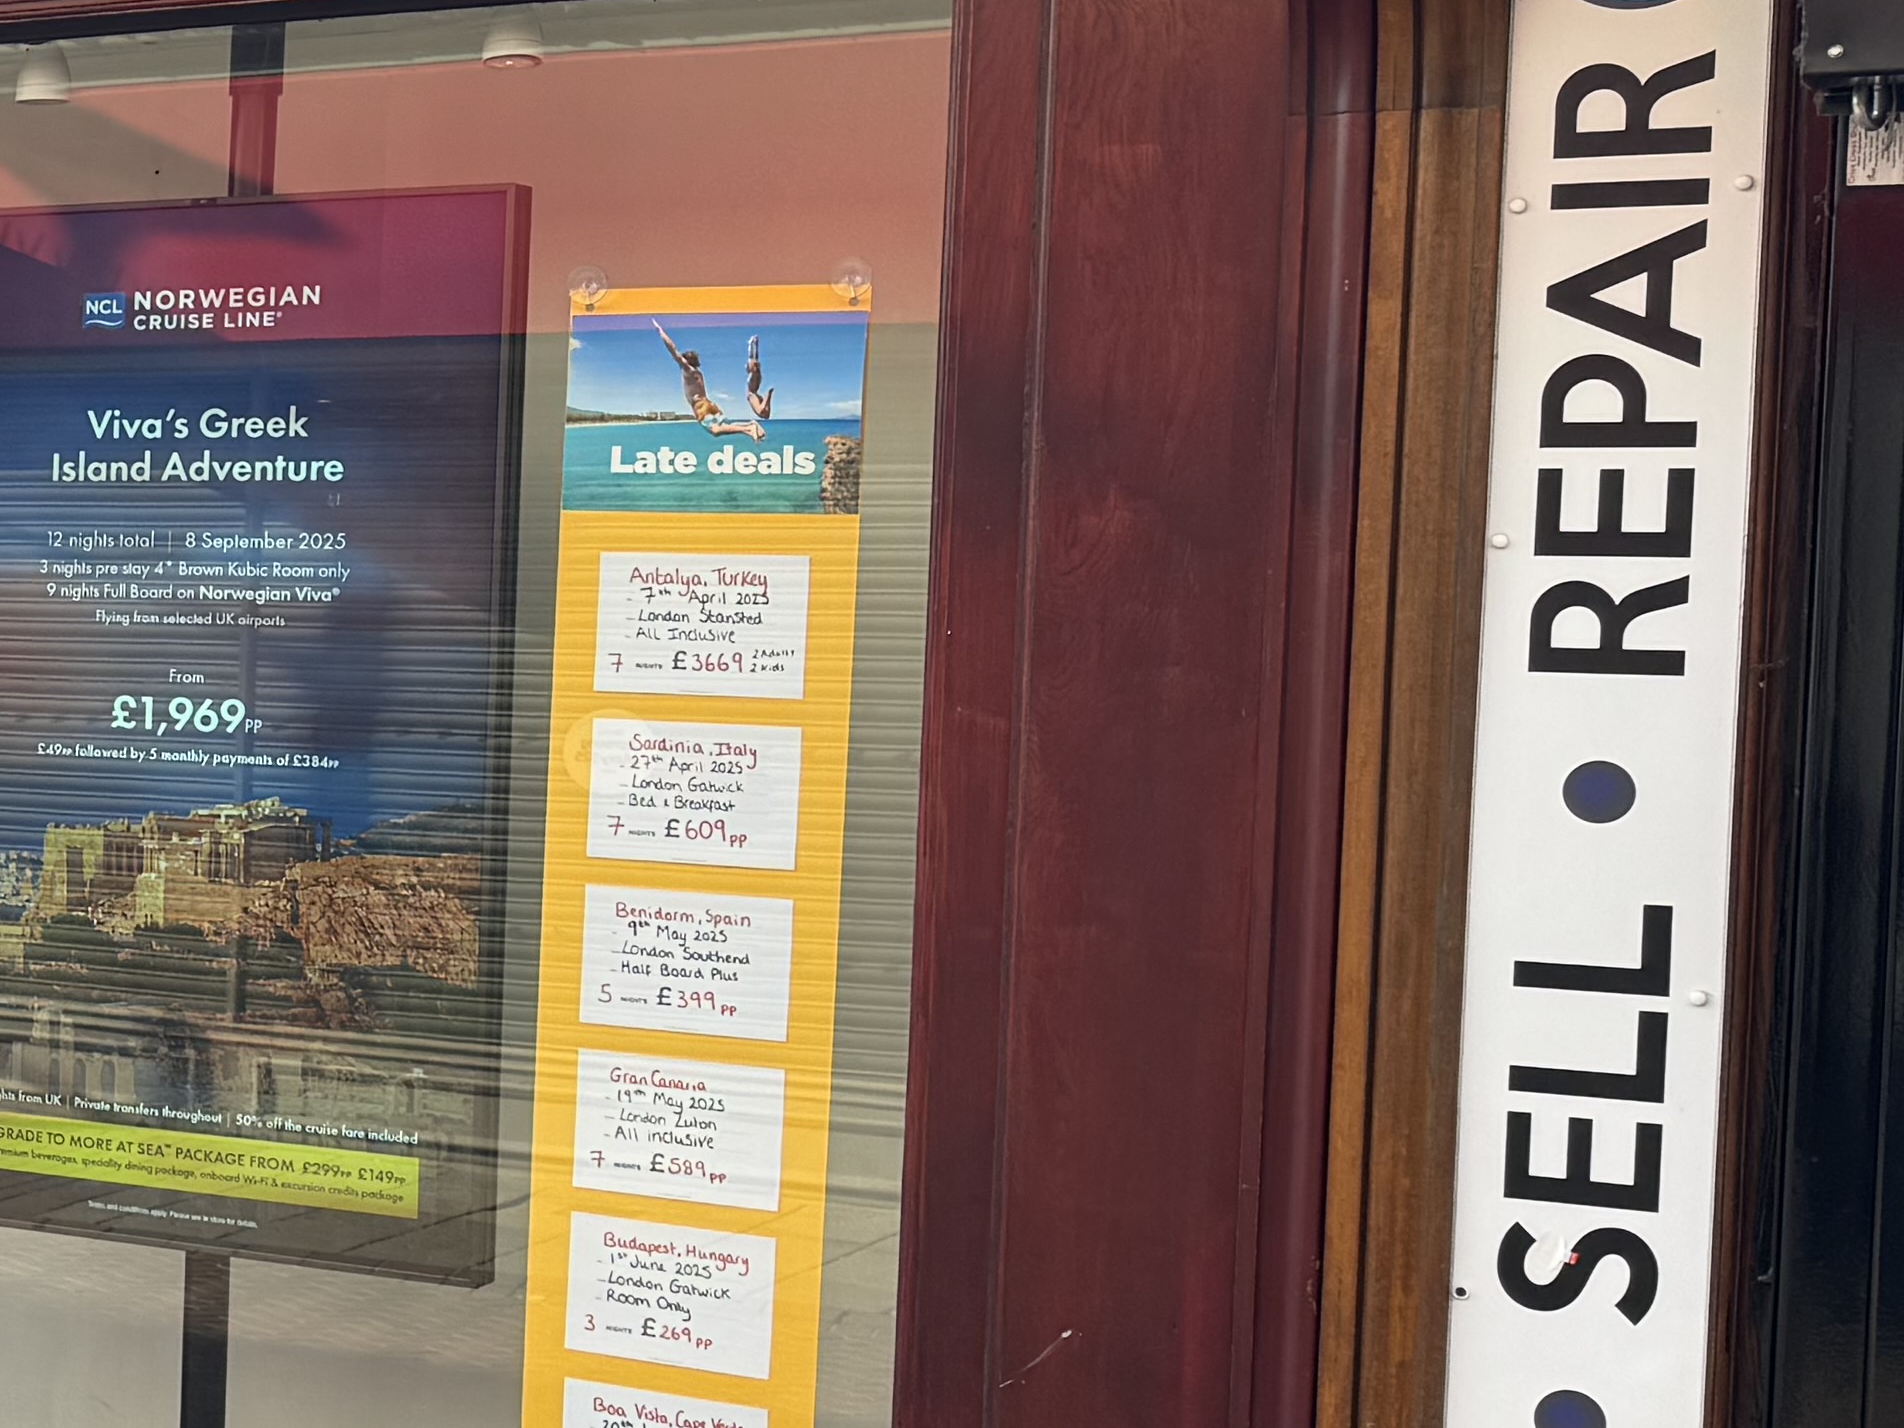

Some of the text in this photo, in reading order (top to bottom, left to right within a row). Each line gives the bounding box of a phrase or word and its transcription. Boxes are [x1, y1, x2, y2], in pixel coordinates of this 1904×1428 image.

[85, 284, 322, 315] NCL NORWEGIAN
[133, 313, 215, 331] CRUISE
[1528, 47, 1717, 681] REPAIR
[87, 404, 309, 440] Viva's Greek
[52, 450, 344, 483] Island Adventure
[610, 445, 816, 475] Late deals
[47, 530, 155, 551] 12 nights total
[185, 531, 346, 553] 8 September 2025
[712, 567, 767, 596] Turkey
[199, 585, 290, 605] Norwegian
[638, 609, 689, 623] London
[671, 650, 743, 673] £3669
[168, 668, 205, 684] From
[674, 795, 736, 813] Breakfast
[664, 818, 727, 843] £609
[682, 946, 750, 965] Southend
[656, 986, 716, 1011] £399
[18, 1090, 62, 1106] from UK
[1501, 900, 1674, 1323] SELL
[47, 1131, 65, 1145] TO
[70, 1136, 113, 1151] MORE
[175, 1147, 295, 1173] PACKAGE FROM
[669, 1278, 731, 1300] Gatwick
